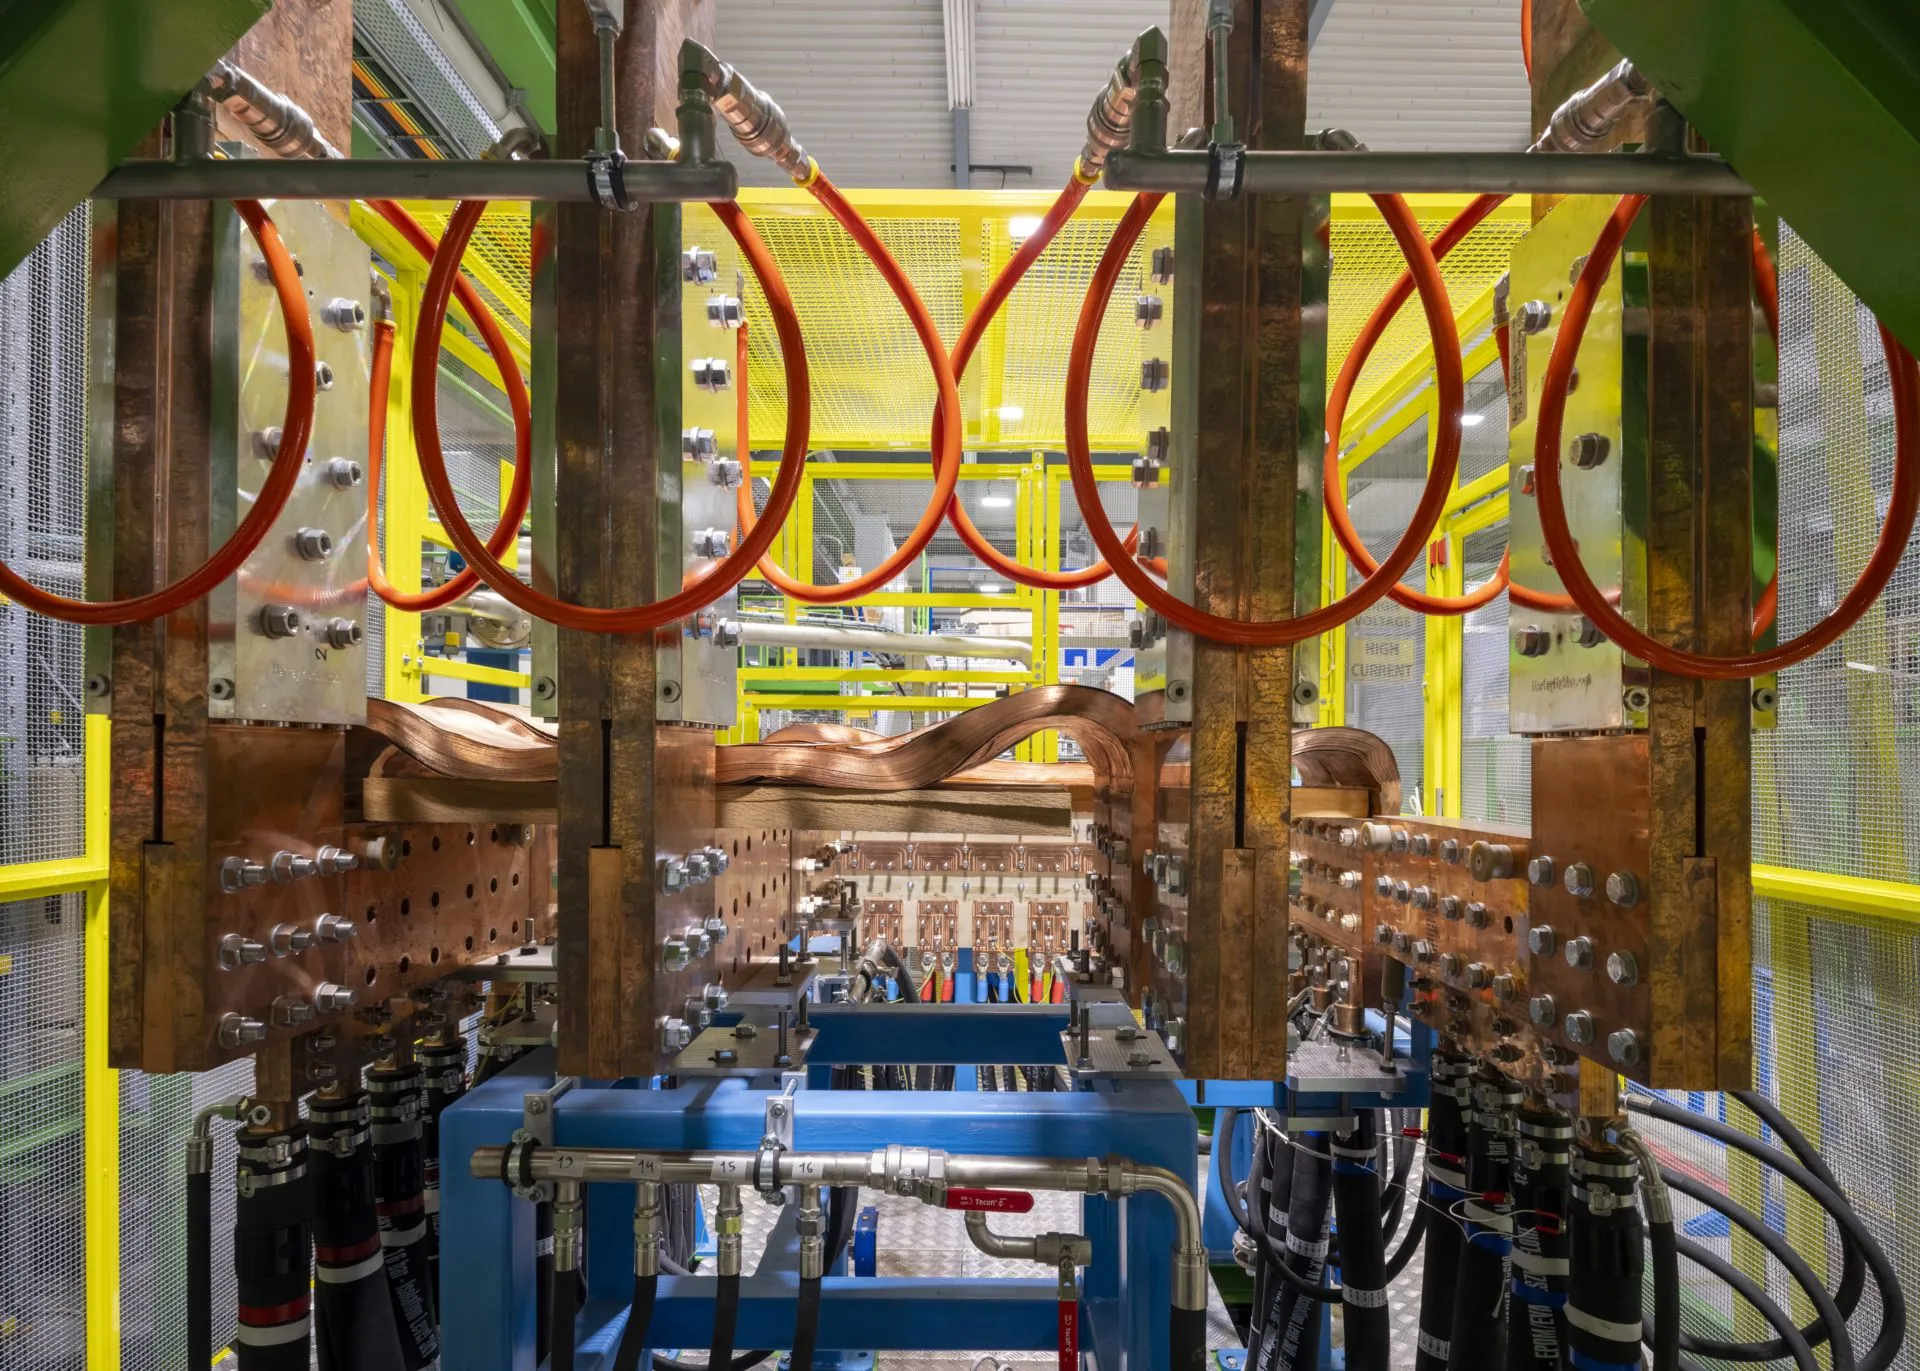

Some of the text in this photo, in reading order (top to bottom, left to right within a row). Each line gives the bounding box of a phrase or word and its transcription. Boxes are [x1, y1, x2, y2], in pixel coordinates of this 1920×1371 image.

[1355, 616, 1412, 627] VOLTAGE
[1366, 642, 1400, 655] HIGH
[1351, 664, 1413, 677] CURRENT
[638, 1159, 654, 1172] 14
[720, 1161, 736, 1173] 15
[799, 1162, 813, 1174] 16
